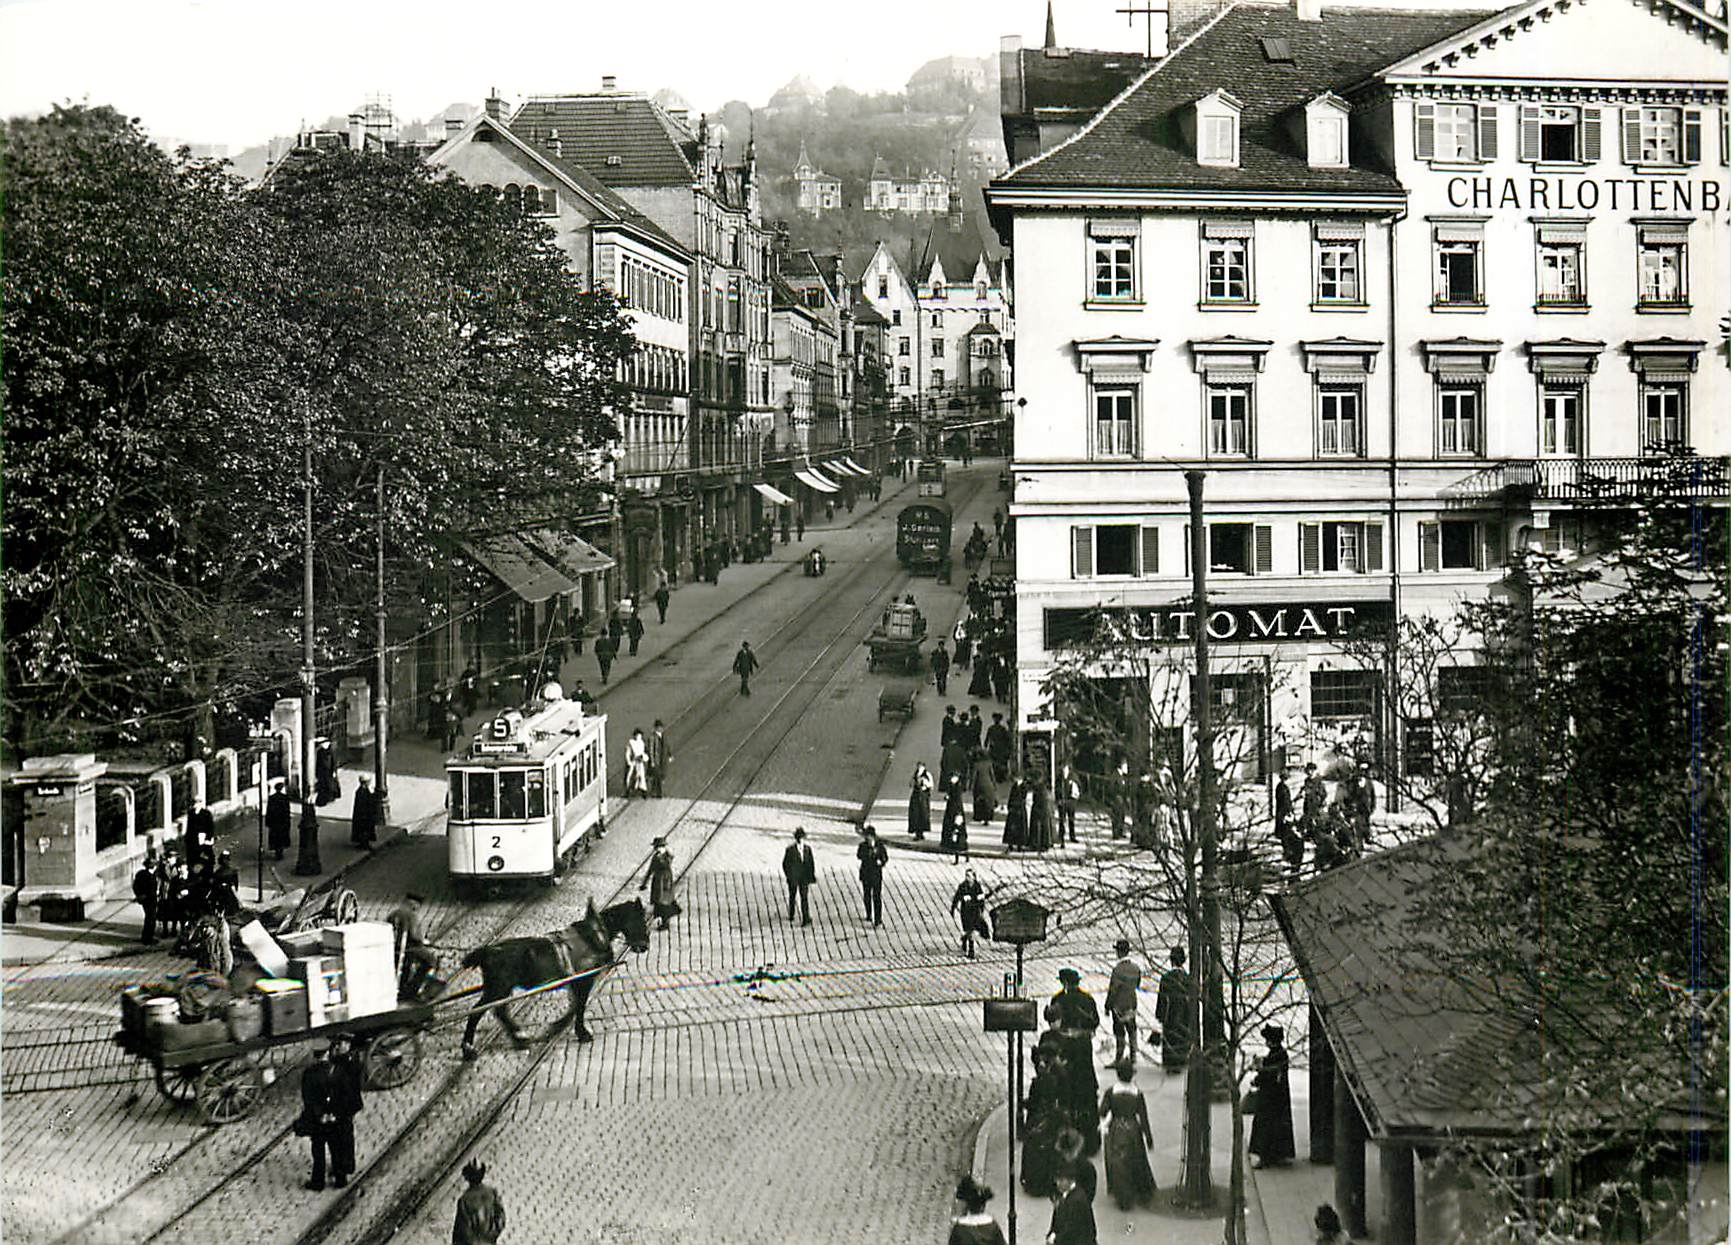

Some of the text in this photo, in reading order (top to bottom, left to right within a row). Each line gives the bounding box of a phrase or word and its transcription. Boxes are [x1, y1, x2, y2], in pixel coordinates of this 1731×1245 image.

[1447, 177, 1730, 212] CHARLOTTENB
[1100, 608, 1355, 640] AUTOMAT
[491, 836, 501, 848] 2
